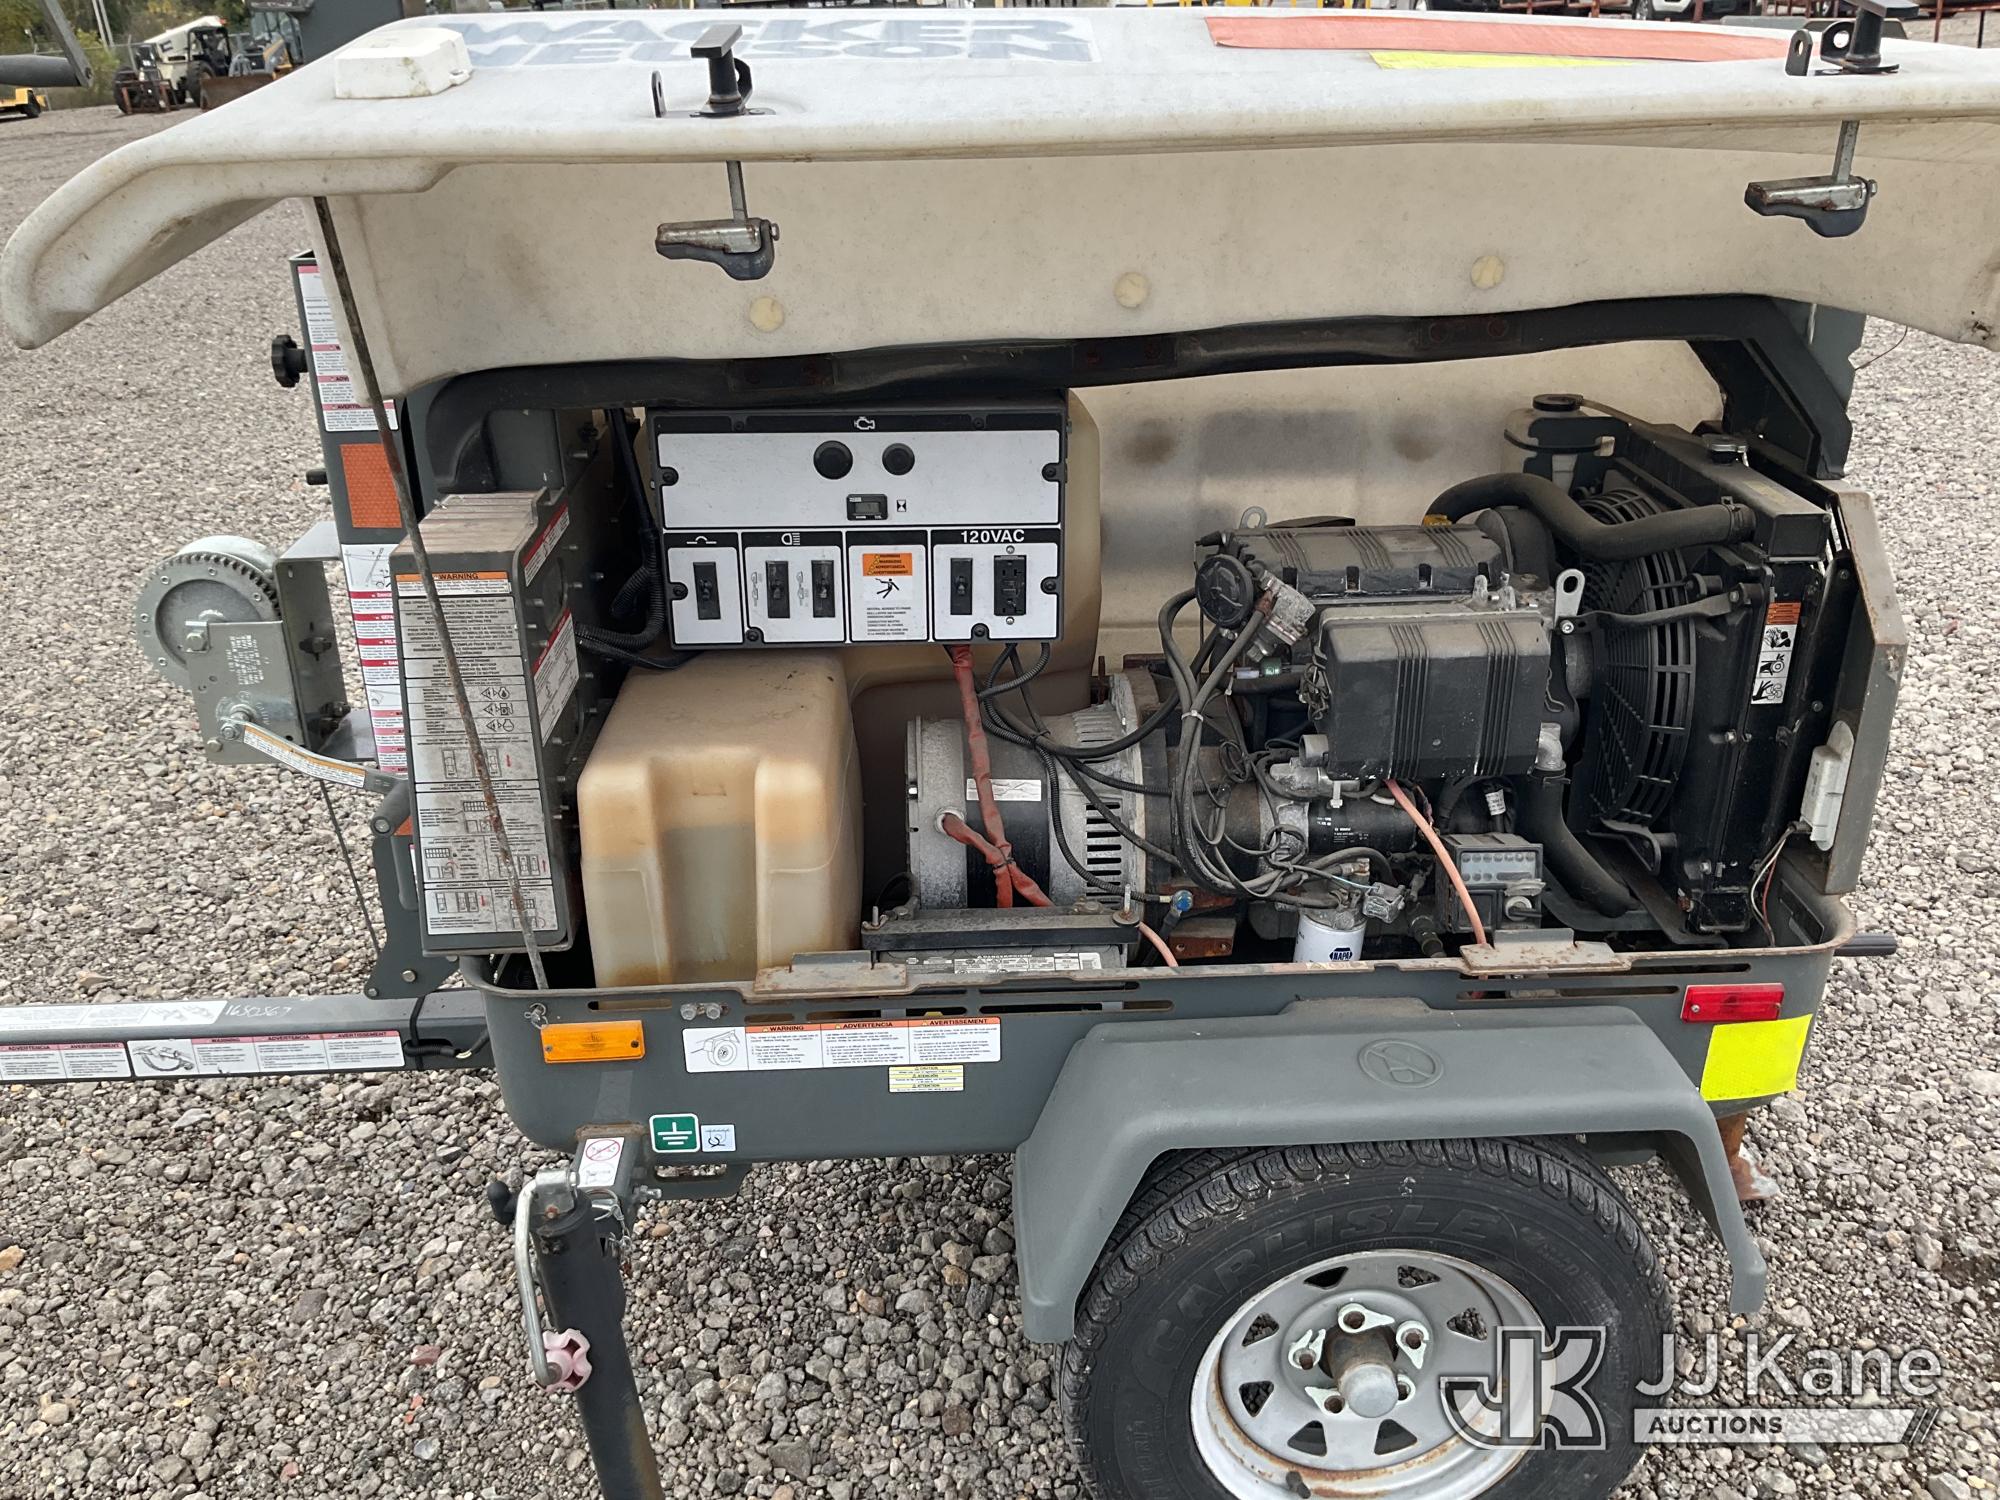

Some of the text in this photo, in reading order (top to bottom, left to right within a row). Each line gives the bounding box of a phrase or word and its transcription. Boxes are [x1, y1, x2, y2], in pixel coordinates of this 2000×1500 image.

[439, 19, 1087, 44] WACKER
[961, 529, 1025, 544] 120VAC
[930, 1018, 987, 1026] AVERTISSEMENT
[1147, 1203, 1503, 1359] CARLISLE
